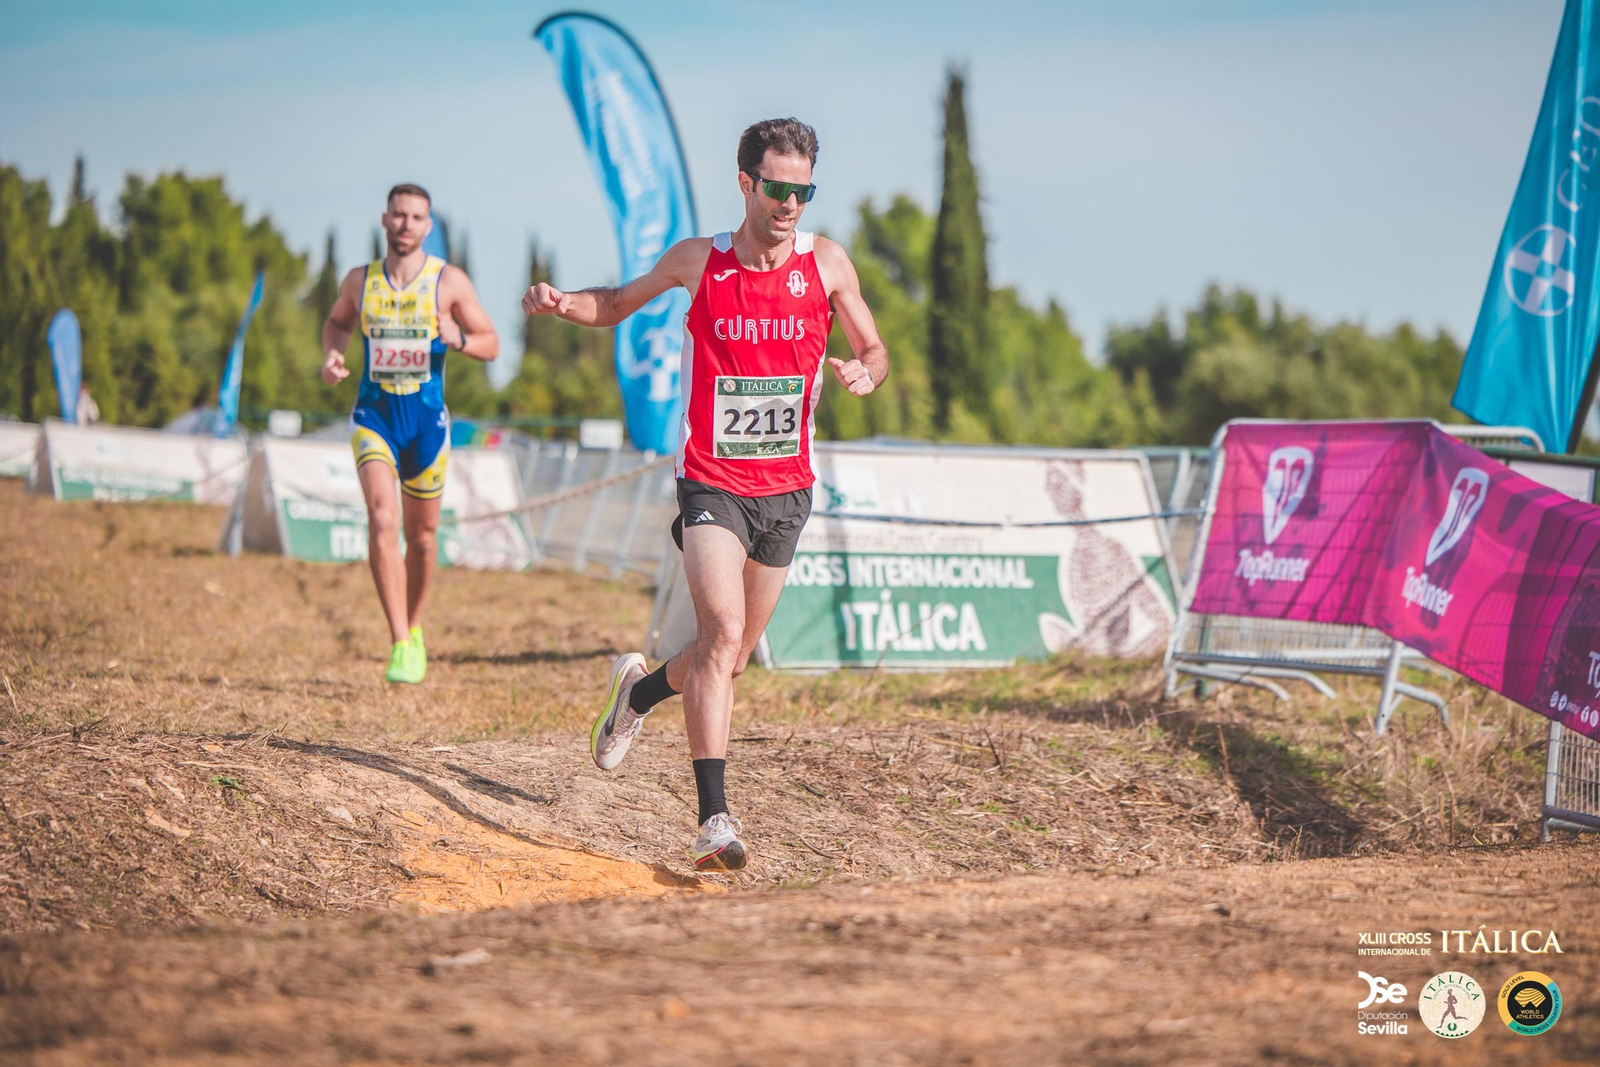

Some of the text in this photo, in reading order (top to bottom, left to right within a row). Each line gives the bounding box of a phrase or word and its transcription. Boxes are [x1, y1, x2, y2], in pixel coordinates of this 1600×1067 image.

[714, 315, 805, 345] CURTIUS
[374, 349, 426, 367] 2250
[742, 379, 784, 391] ITÁLICA
[723, 407, 796, 435] 2213
[848, 555, 1034, 589] INTERNACIONAL
[1235, 549, 1311, 587] TopRunner
[1401, 566, 1454, 616] TopRunner
[840, 588, 988, 651] ITÁLICA
